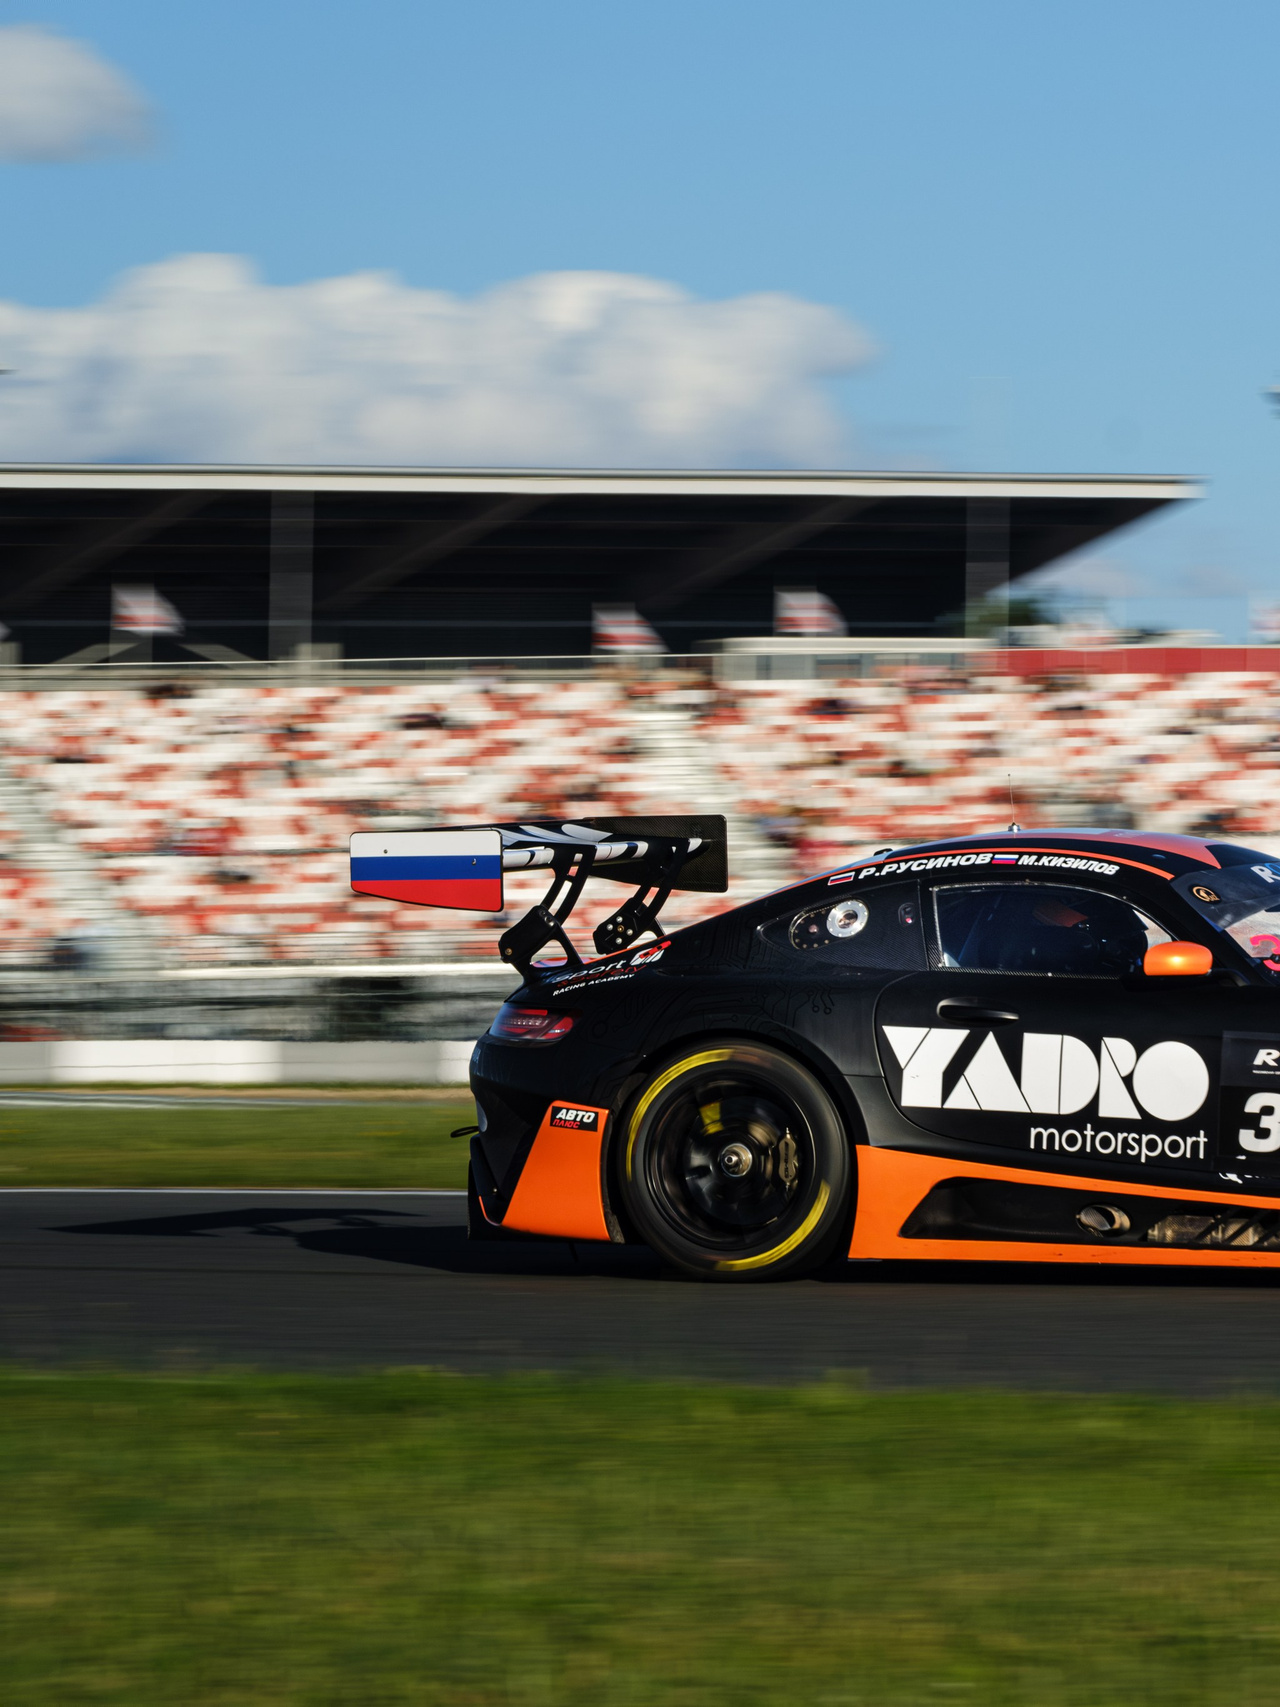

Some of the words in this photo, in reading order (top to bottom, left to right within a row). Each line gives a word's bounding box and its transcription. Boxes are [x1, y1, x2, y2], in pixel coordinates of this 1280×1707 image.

[858, 853, 994, 880] Р.РУСИНОВ
[1018, 855, 1120, 876] М.КИЗИЛОВ
[881, 1025, 1210, 1122] YADRO
[552, 1119, 581, 1129] ПЛЮС
[555, 1108, 596, 1124] АВТО
[1029, 1123, 1208, 1164] motorsport
